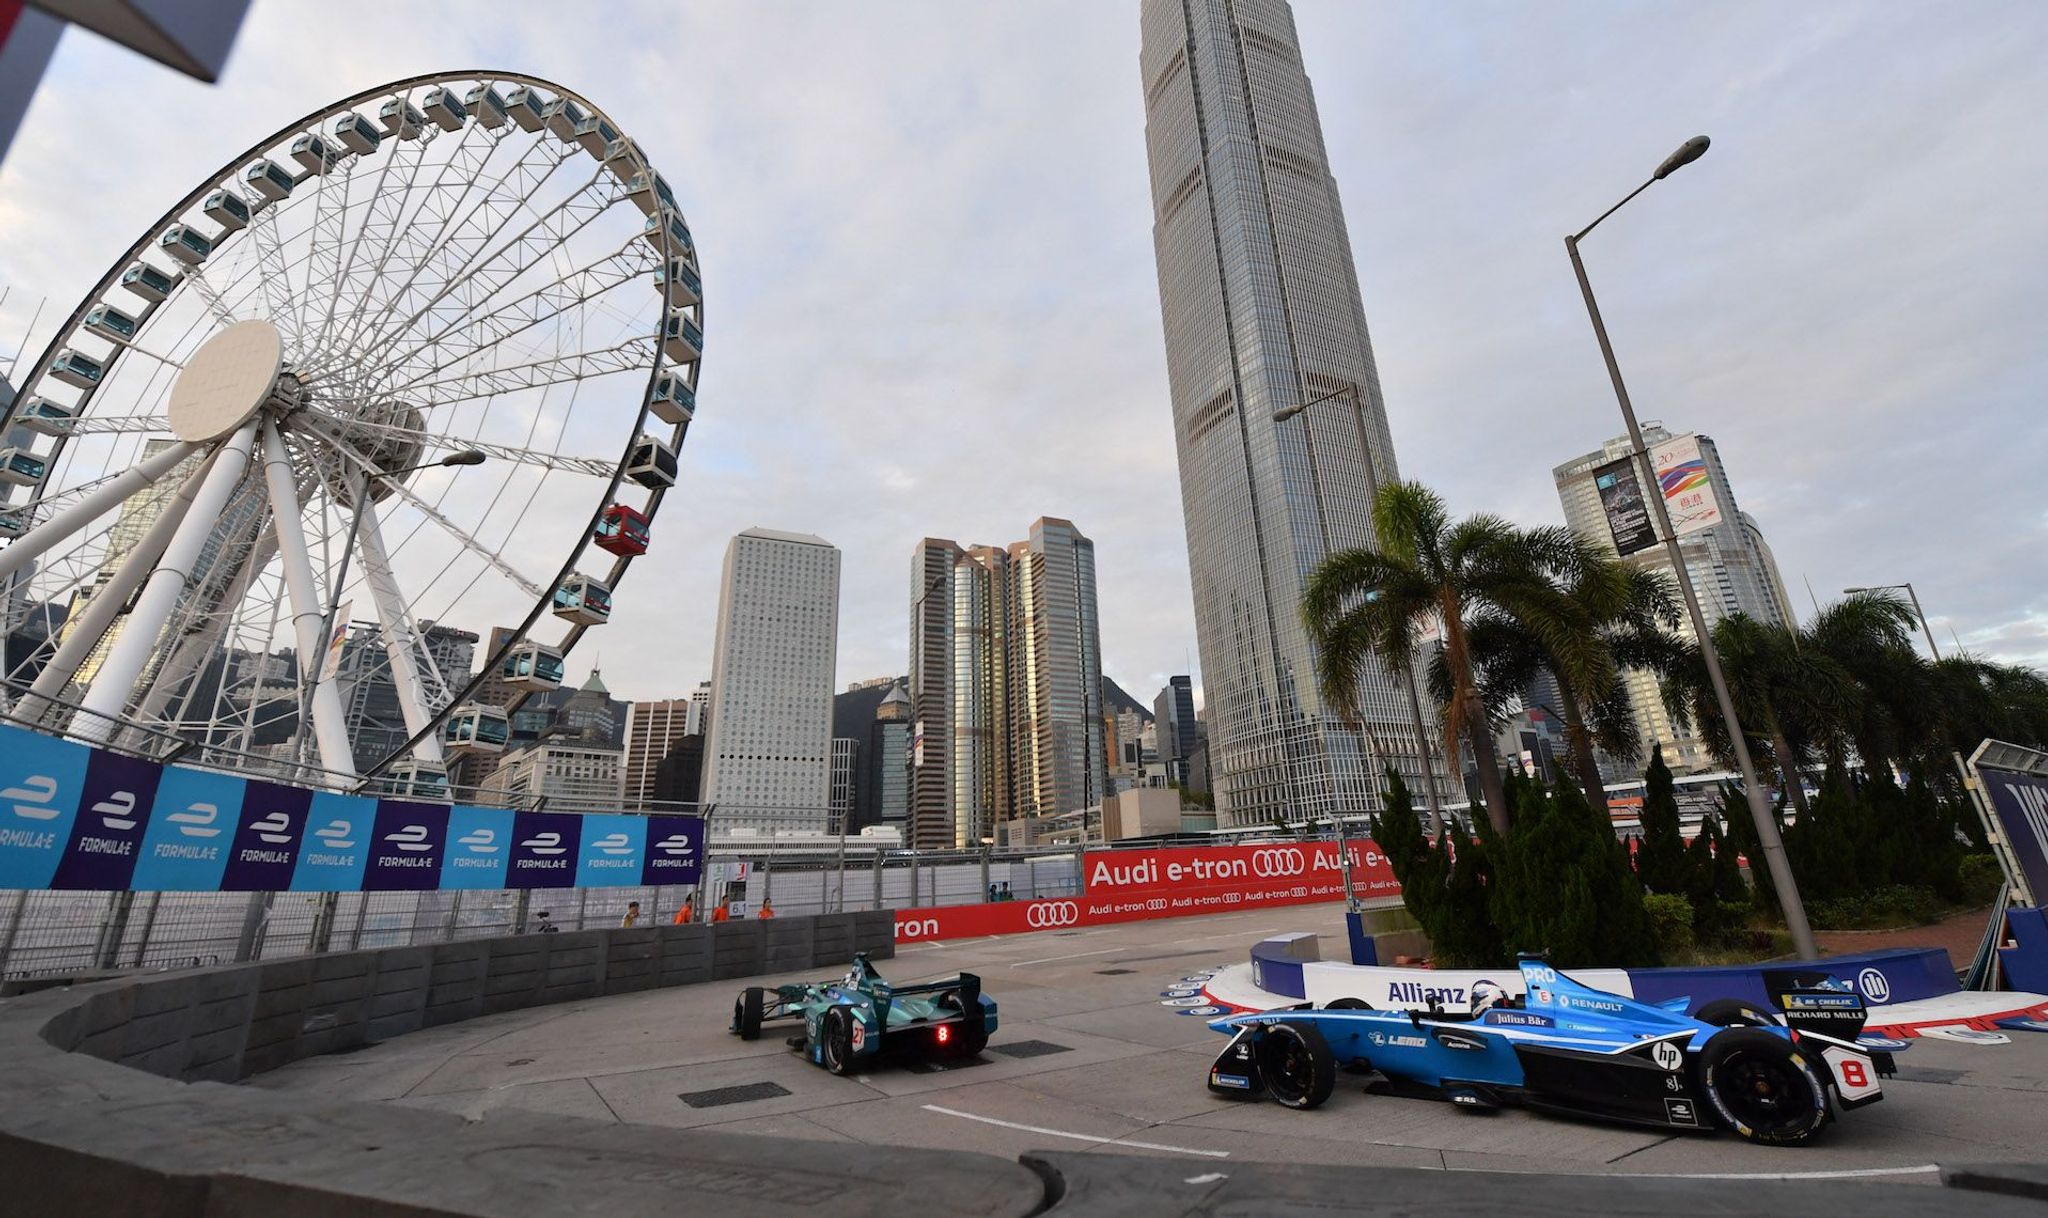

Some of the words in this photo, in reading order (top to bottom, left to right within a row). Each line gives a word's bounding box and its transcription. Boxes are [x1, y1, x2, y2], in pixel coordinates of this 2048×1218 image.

[0, 829, 55, 849] RMULA-E
[1090, 858, 1158, 887] Audi
[1167, 859, 1247, 881] e-tron
[1311, 886, 1329, 895] Audi
[1370, 881, 1386, 889] Audi
[1171, 897, 1193, 907] Audi
[1194, 896, 1221, 906] e-tron
[1245, 891, 1263, 901] Audi
[1265, 890, 1290, 899] e-tron
[1088, 903, 1112, 915] Audi
[1114, 902, 1145, 913] e-tron
[894, 919, 938, 938] ron
[1522, 967, 1556, 983] PRO
[1388, 982, 1467, 1004] Allianz
[1572, 999, 1623, 1012] RENAULT
[1497, 1013, 1525, 1024] Julius
[1528, 1015, 1546, 1026] Bär
[1786, 1011, 1831, 1019] RICHARD
[1834, 1011, 1865, 1019] MILLE
[852, 1027, 865, 1044] 27
[1388, 1035, 1427, 1048] LEMO
[1659, 1041, 1677, 1070] hp
[1840, 1060, 1868, 1087] 8
